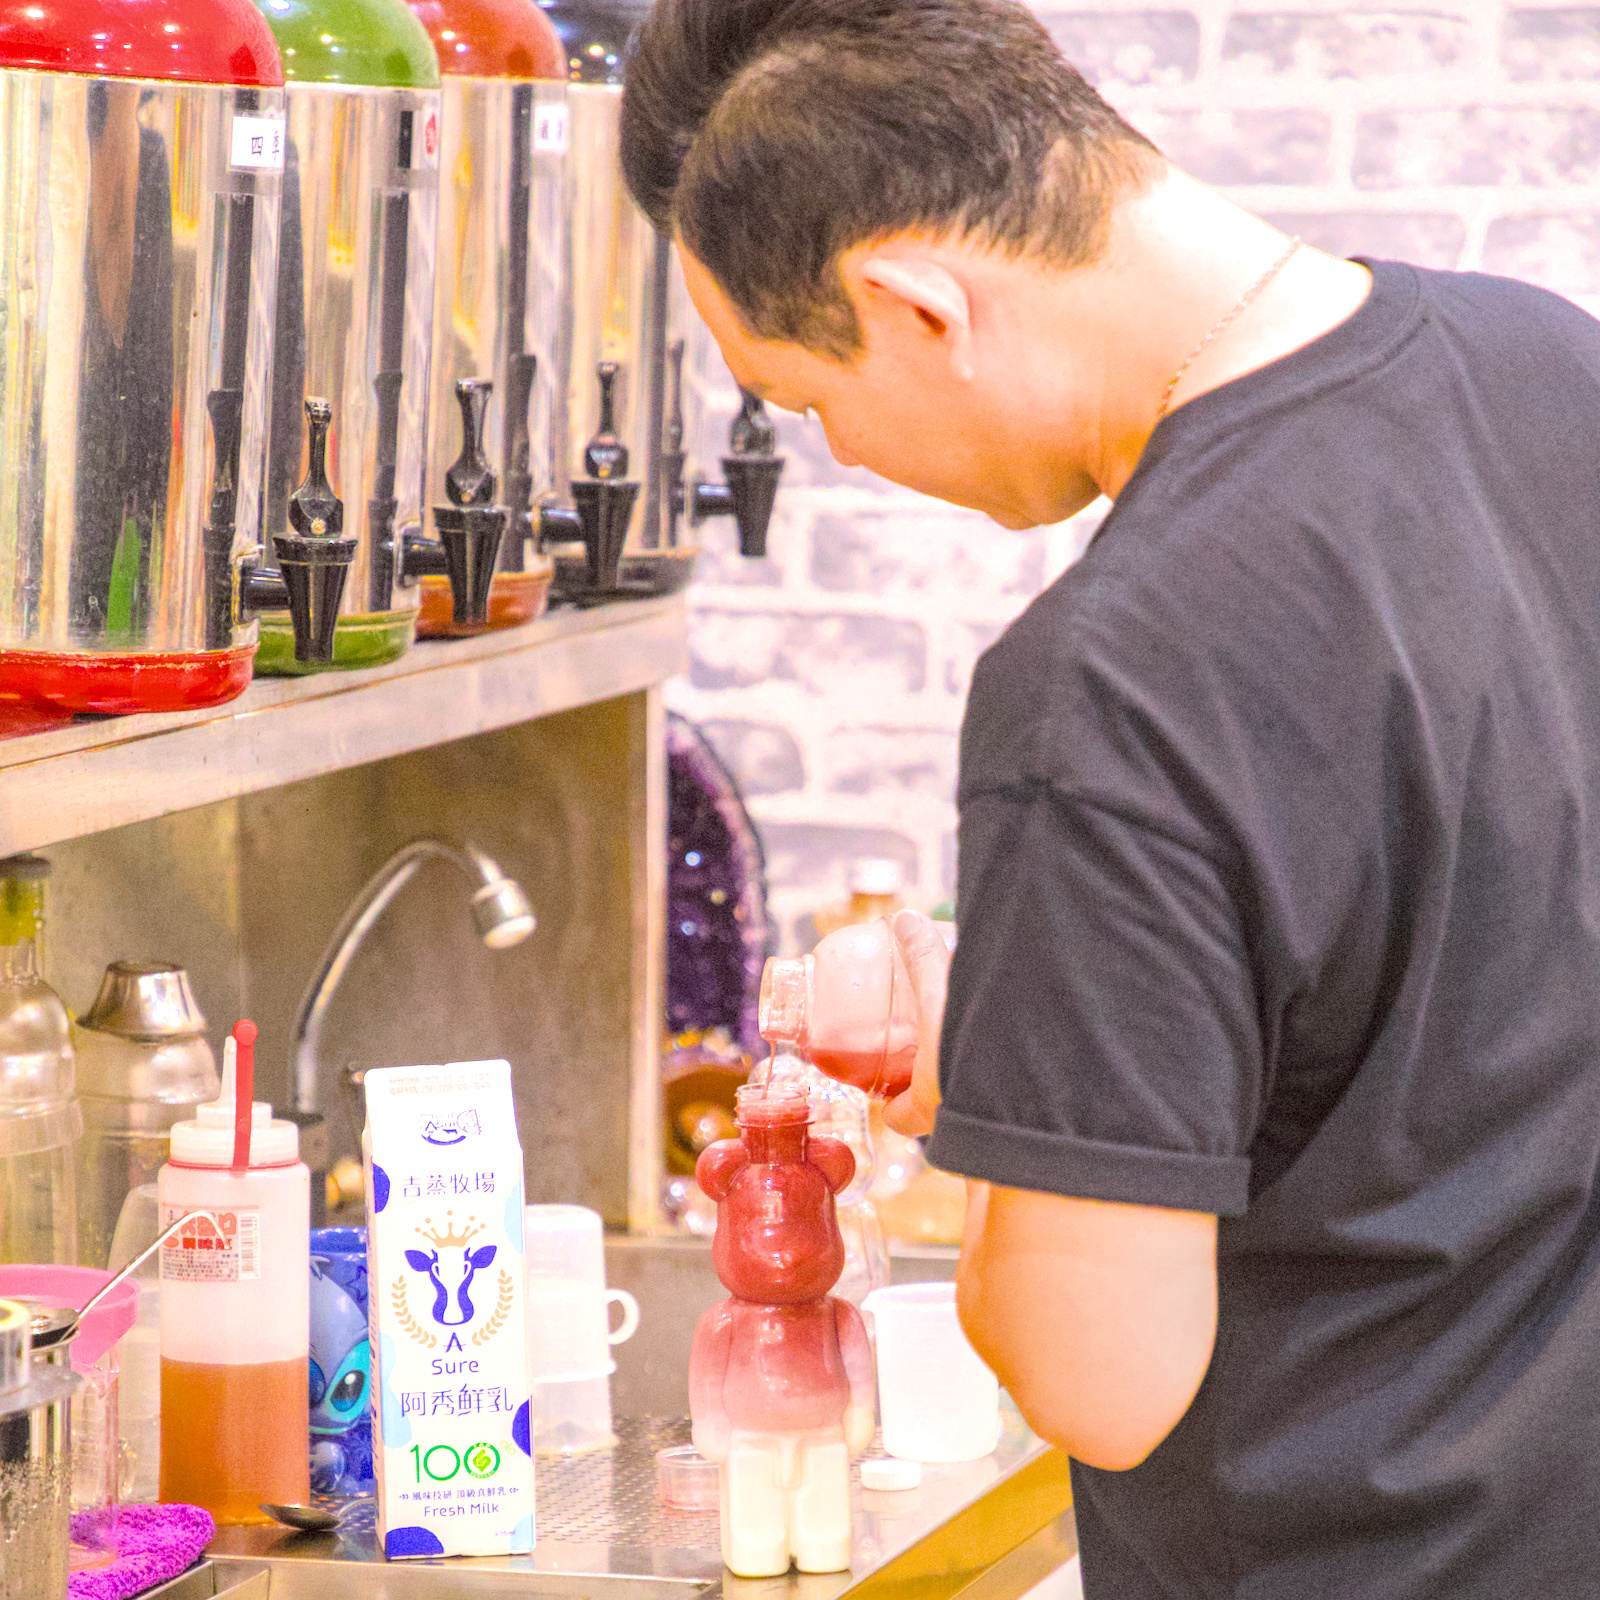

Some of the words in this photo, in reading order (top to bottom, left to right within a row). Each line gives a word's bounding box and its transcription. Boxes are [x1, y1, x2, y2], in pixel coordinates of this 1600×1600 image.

[403, 1172, 496, 1198] 吉蒸牧場
[431, 1358, 479, 1376] Sure
[401, 1383, 514, 1418] 阿秀鮮乳
[424, 1505, 466, 1518] Fresh
[470, 1502, 500, 1515] Milk
